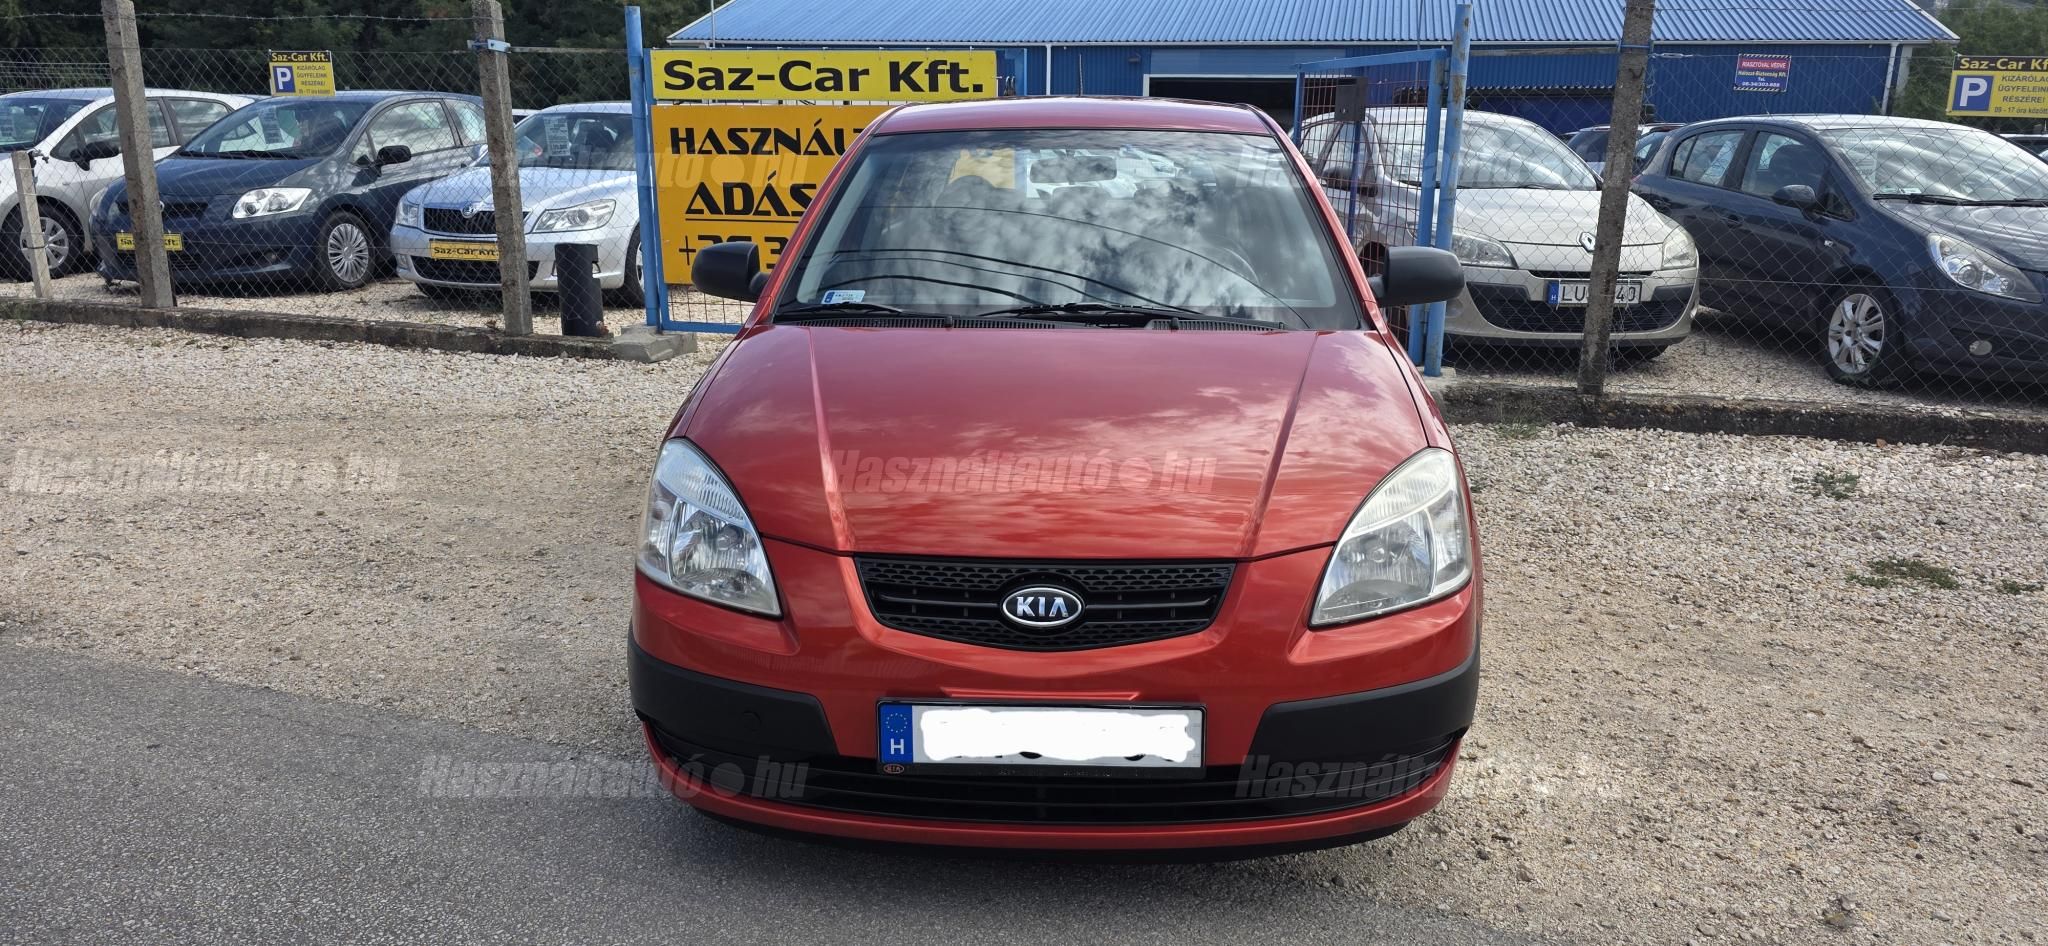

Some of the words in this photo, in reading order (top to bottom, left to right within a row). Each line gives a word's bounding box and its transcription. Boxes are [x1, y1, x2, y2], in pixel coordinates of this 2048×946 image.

[272, 52, 307, 61] Saz-Car
[310, 52, 328, 61] Kft.
[1959, 57, 2026, 70] Saz-Car
[276, 67, 292, 90] P
[663, 60, 870, 92] Saz-Car
[888, 60, 984, 93] Kft.
[1959, 77, 1988, 107] P
[433, 246, 476, 256] Saz-Car
[1016, 596, 1069, 618] KIA
[890, 738, 905, 755] H
